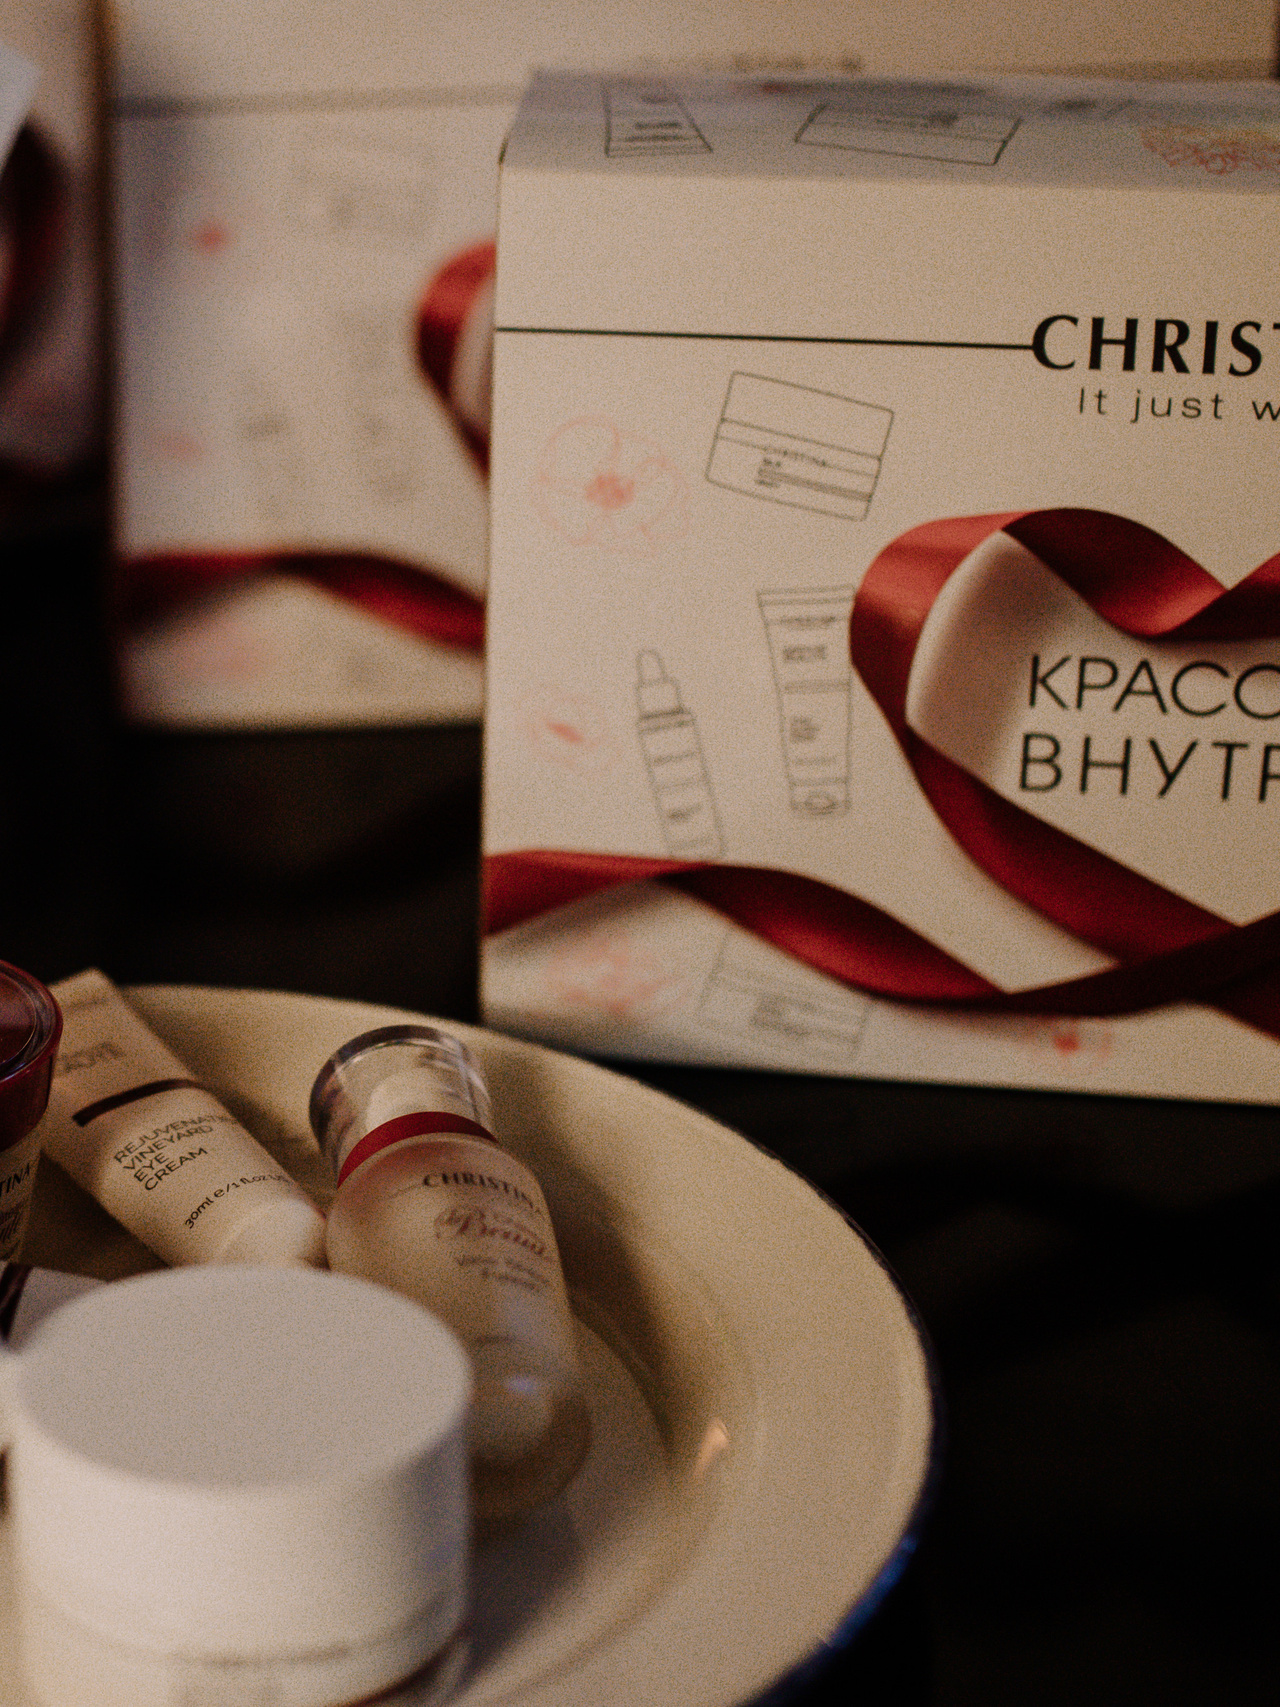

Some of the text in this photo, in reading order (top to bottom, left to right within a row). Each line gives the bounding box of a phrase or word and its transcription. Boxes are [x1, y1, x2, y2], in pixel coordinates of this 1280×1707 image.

[1031, 313, 1280, 378] CHRIS
[1076, 386, 1108, 416] It
[1130, 388, 1225, 424] just
[123, 1124, 214, 1172] VINEYARD
[133, 1152, 170, 1183] EYE
[144, 1146, 209, 1192] CREAM
[183, 1195, 215, 1230] 30ml
